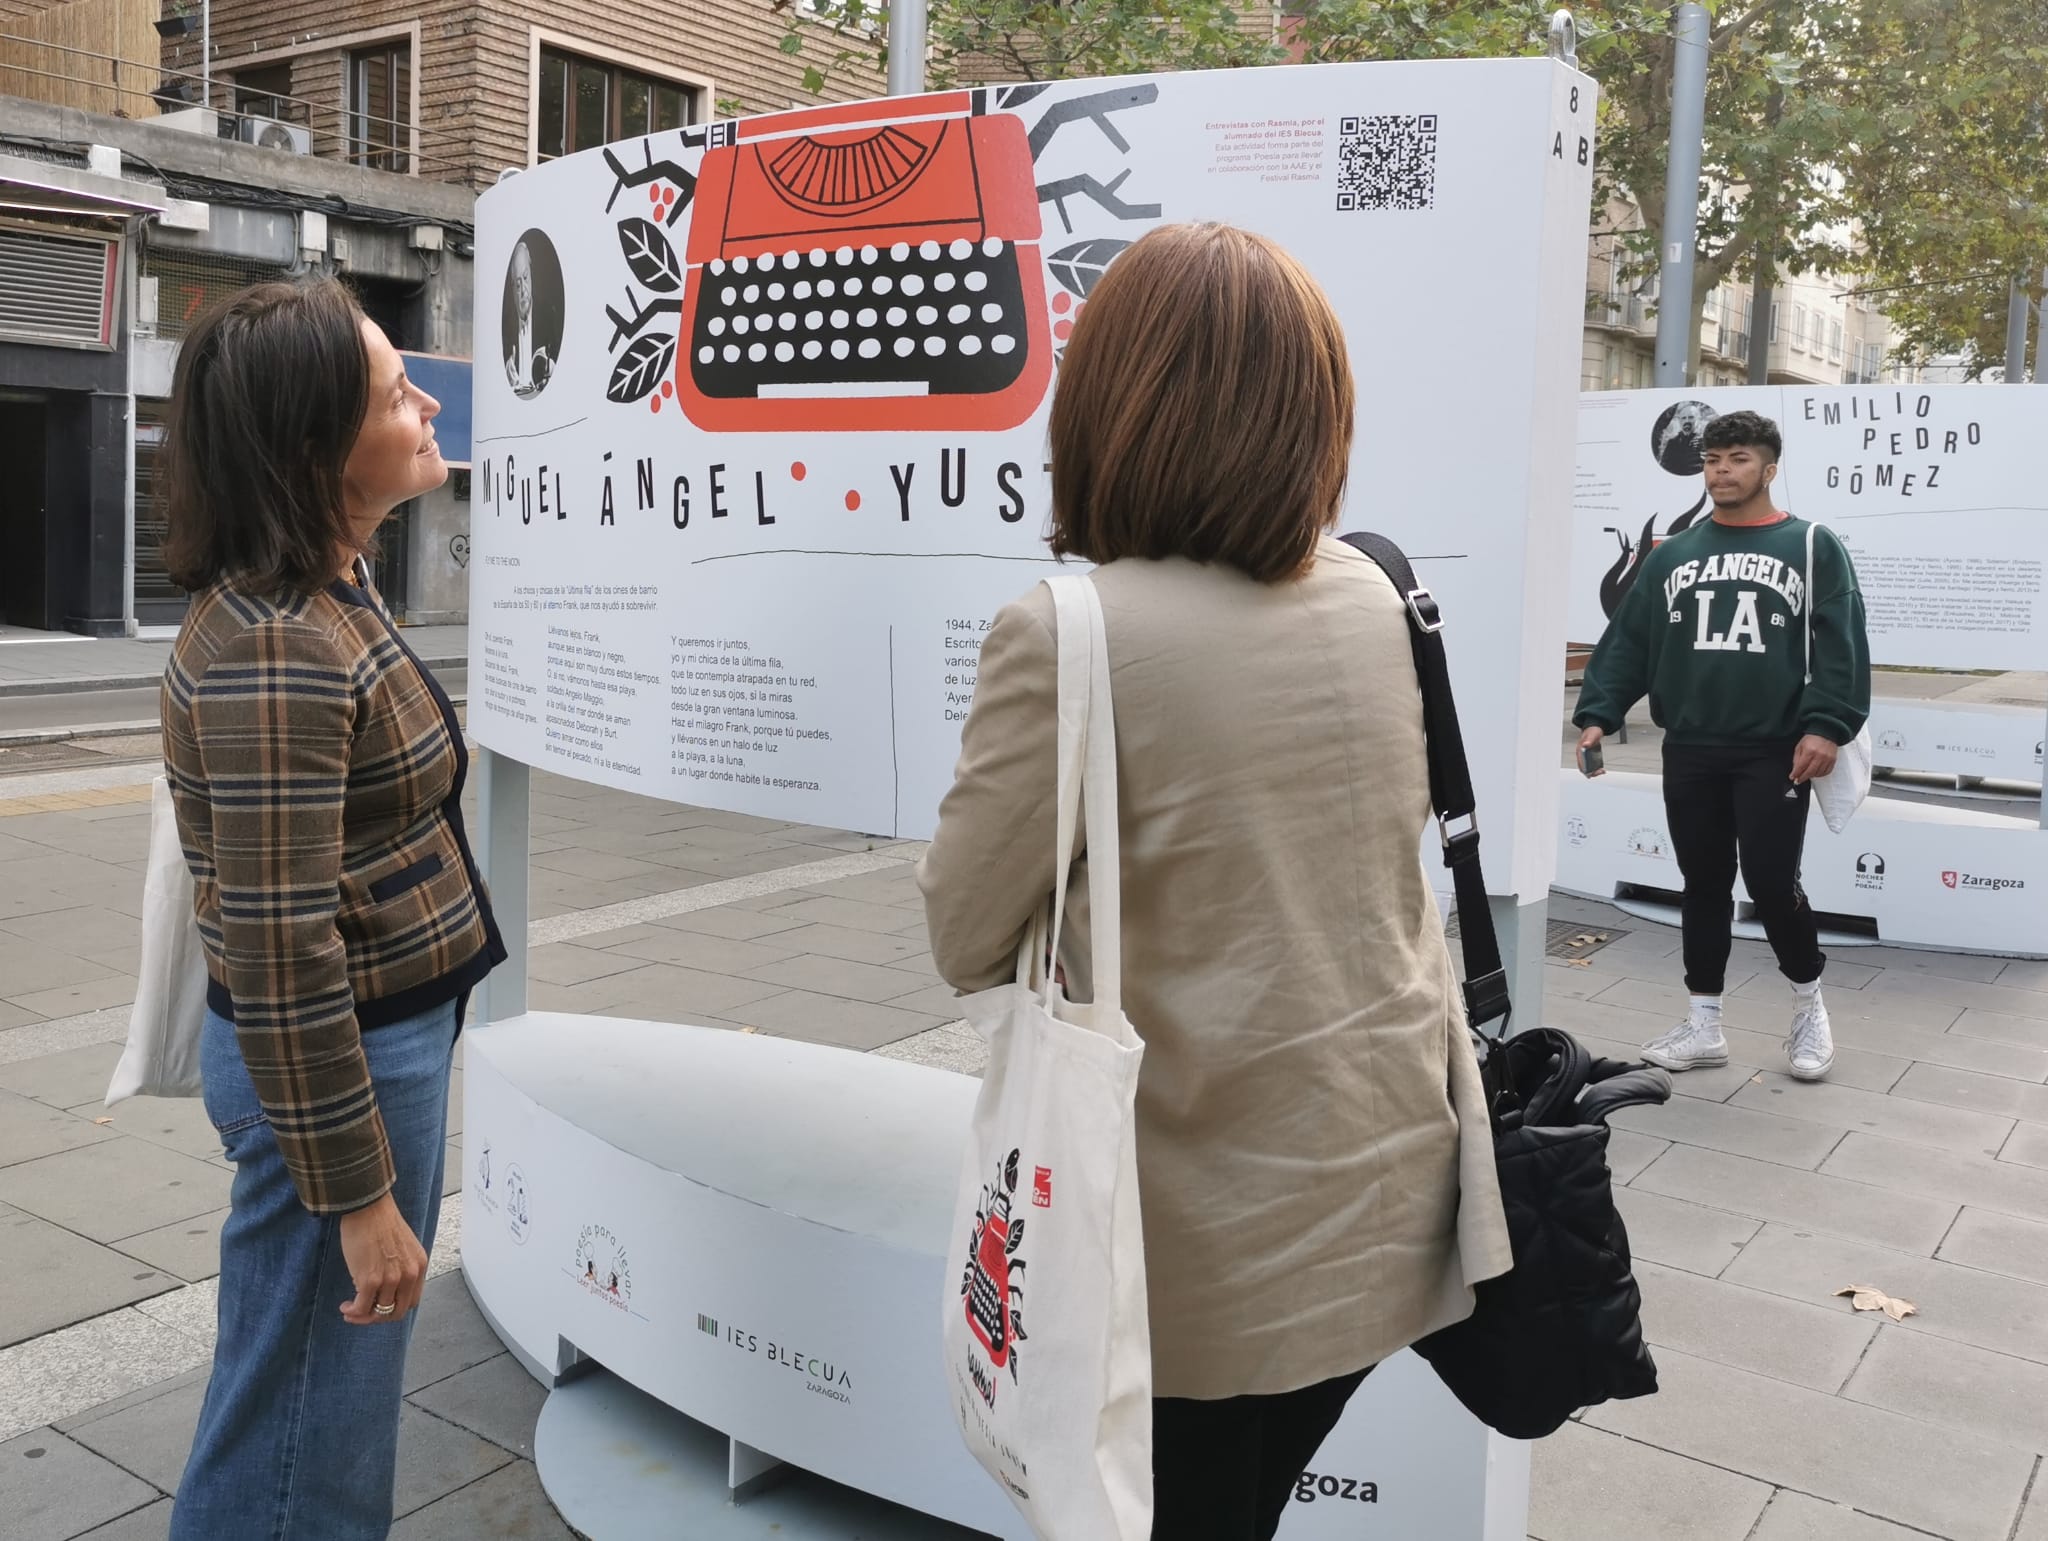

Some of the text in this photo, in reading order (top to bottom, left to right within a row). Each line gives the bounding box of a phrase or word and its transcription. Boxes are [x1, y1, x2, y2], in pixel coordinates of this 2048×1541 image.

[1570, 86, 1578, 113] 8
[1553, 131, 1588, 166] A B
[1804, 392, 1931, 425] EMILIO
[1864, 422, 1980, 455] PEDRO
[483, 448, 1055, 530] MIGUEL ÁNGEL YUS
[1827, 464, 1940, 496] GÓMEZ
[1664, 560, 1700, 612] LOS
[1698, 553, 1805, 616] ANGELES
[946, 619, 975, 631] 1944,
[1669, 590, 1785, 653] 19 LA 89
[672, 636, 750, 650] Y queremos ir juntos,
[672, 654, 784, 669] yo y mi chica de la última fila,
[945, 657, 977, 667] varios
[672, 670, 684, 680] que
[687, 671, 693, 679] te
[696, 672, 734, 682] contempla
[737, 674, 773, 685] atrapada
[776, 676, 786, 685] en
[789, 675, 797, 686] tu
[945, 674, 958, 684] de
[672, 686, 686, 695] todo
[689, 686, 699, 695] luz
[713, 690, 726, 698] sus
[729, 689, 748, 701] ojos,
[750, 691, 757, 699] si
[760, 691, 766, 700] la
[769, 692, 792, 702] miras
[671, 702, 798, 720] desde la gran ventana luminosa.
[672, 717, 832, 741] Haz el milagro Frank, porque tú puedes,
[672, 734, 777, 752] y llévanos en un halo de luz
[678, 750, 684, 759] la
[686, 751, 707, 763] playa,
[717, 754, 724, 763] la
[727, 755, 745, 767] luna,
[689, 767, 707, 780] lugar
[710, 770, 733, 782] donde
[736, 772, 760, 784] habite
[763, 776, 770, 785] la
[773, 778, 821, 791] esperanza.
[1962, 874, 2024, 890] Zaragoza
[728, 1326, 851, 1388] IES BLECUA
[806, 1382, 851, 1404] ZARAGOZA
[1295, 1471, 1378, 1503] goza
